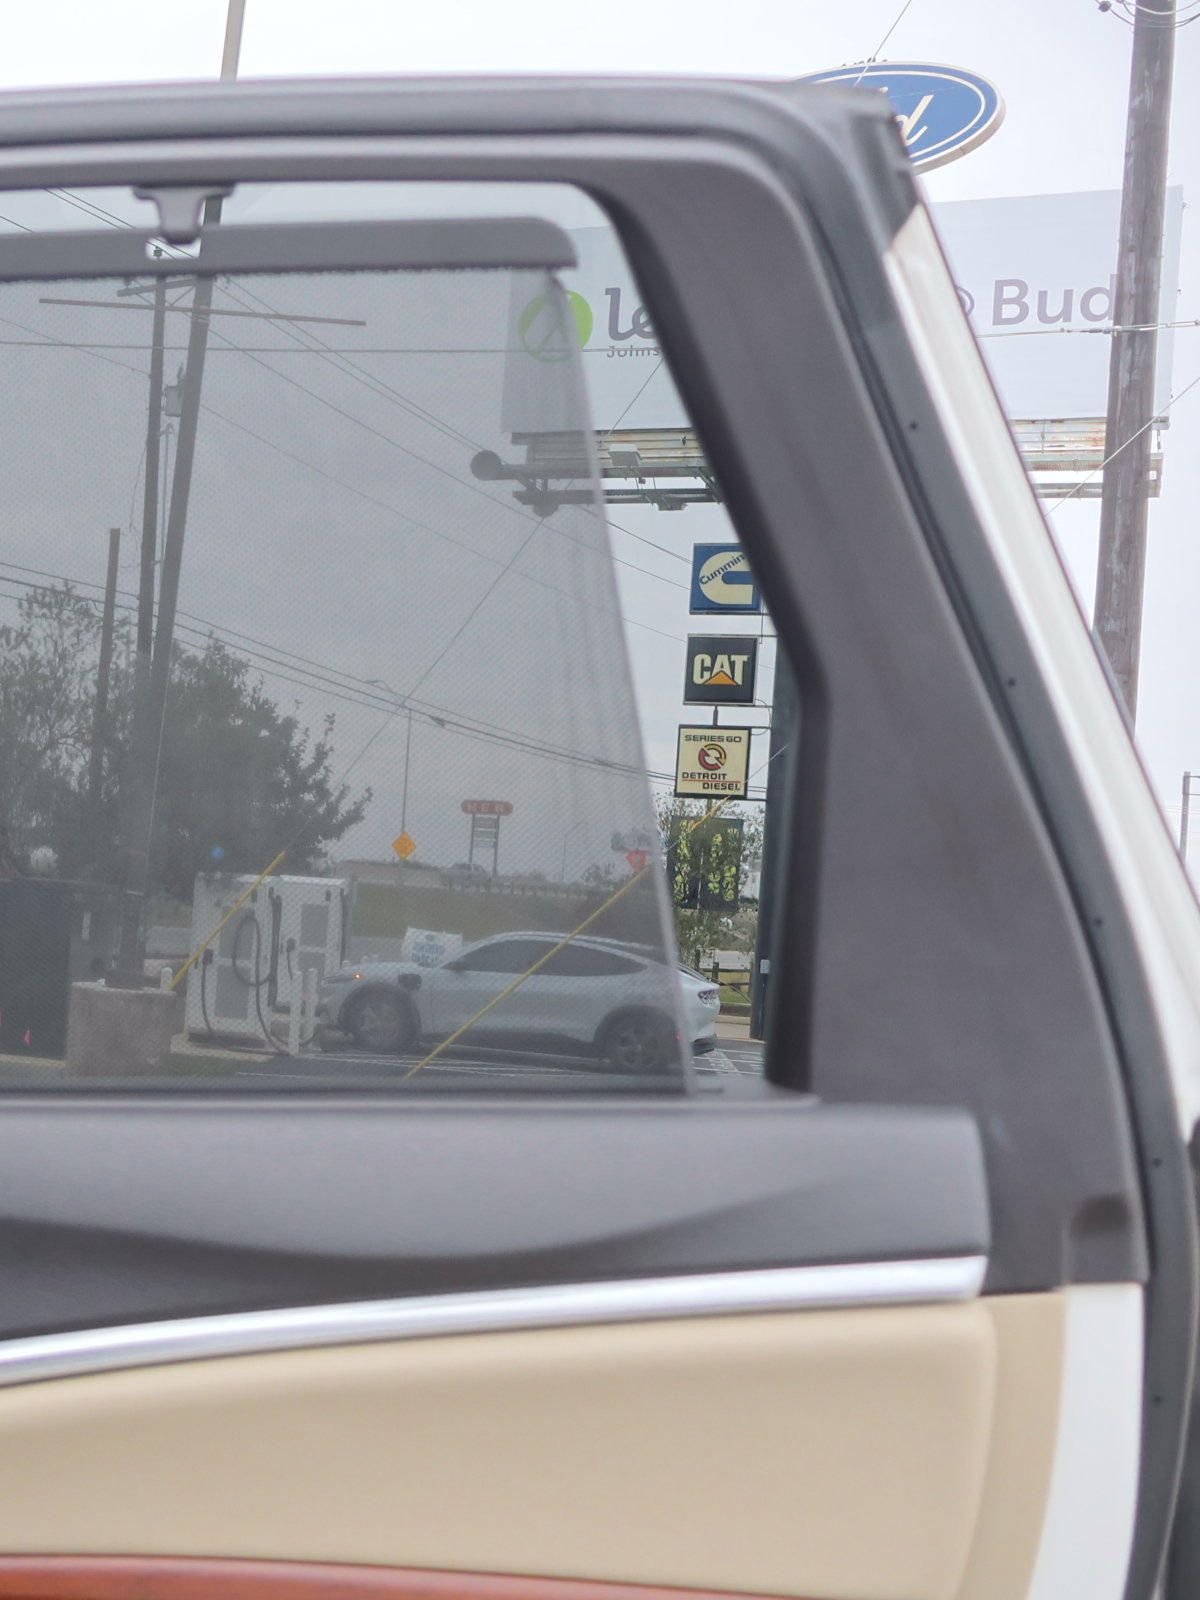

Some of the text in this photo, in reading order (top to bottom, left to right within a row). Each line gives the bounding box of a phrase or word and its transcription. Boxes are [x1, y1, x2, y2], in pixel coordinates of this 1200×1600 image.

[699, 553, 746, 585] Cummin
[693, 653, 749, 686] CAT
[684, 734, 724, 742] SERIES
[682, 771, 727, 780] DETROIT
[702, 782, 740, 791] DIESEL
